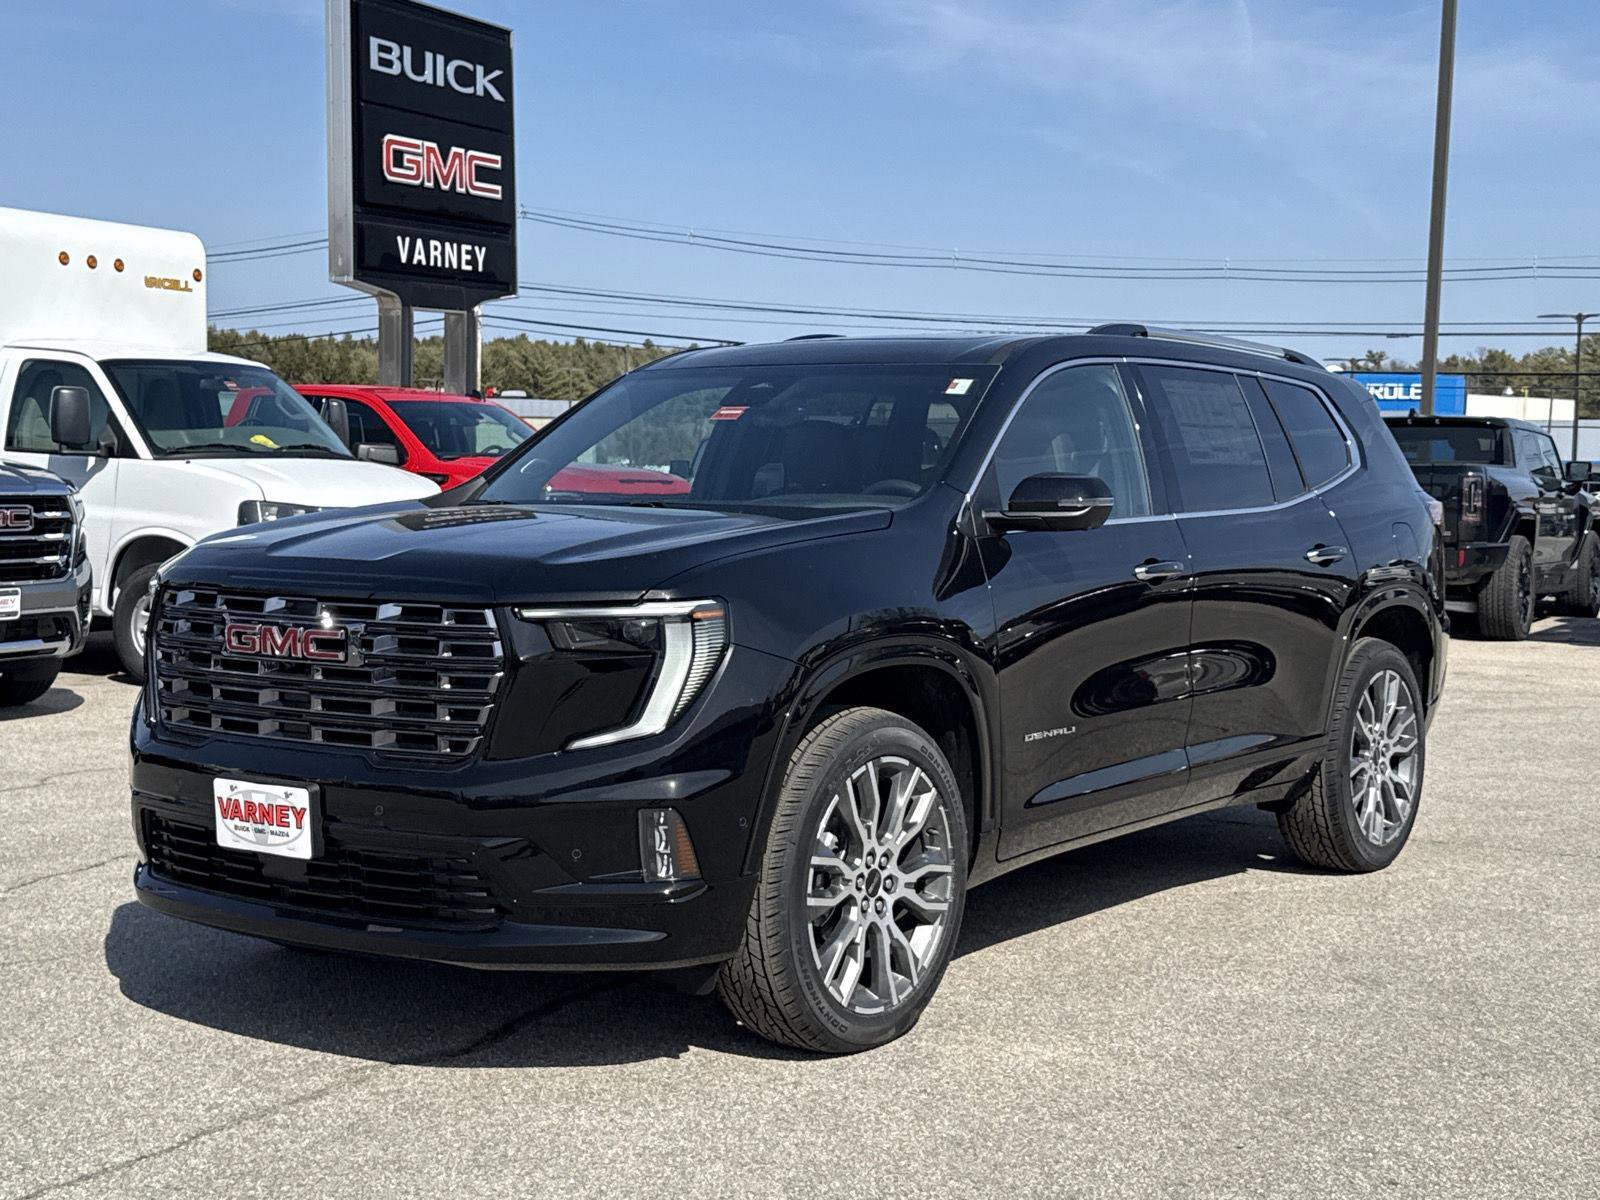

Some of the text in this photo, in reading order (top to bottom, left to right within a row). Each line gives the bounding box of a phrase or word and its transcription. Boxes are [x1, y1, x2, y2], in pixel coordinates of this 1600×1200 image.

[368, 35, 506, 103] BUICK
[382, 133, 502, 200] GMC
[396, 235, 487, 272] VARNEY
[225, 623, 345, 661] GMC
[1024, 726, 1076, 742] DENALI
[216, 795, 307, 830] VARNEY
[270, 829, 290, 838] MAZDA
